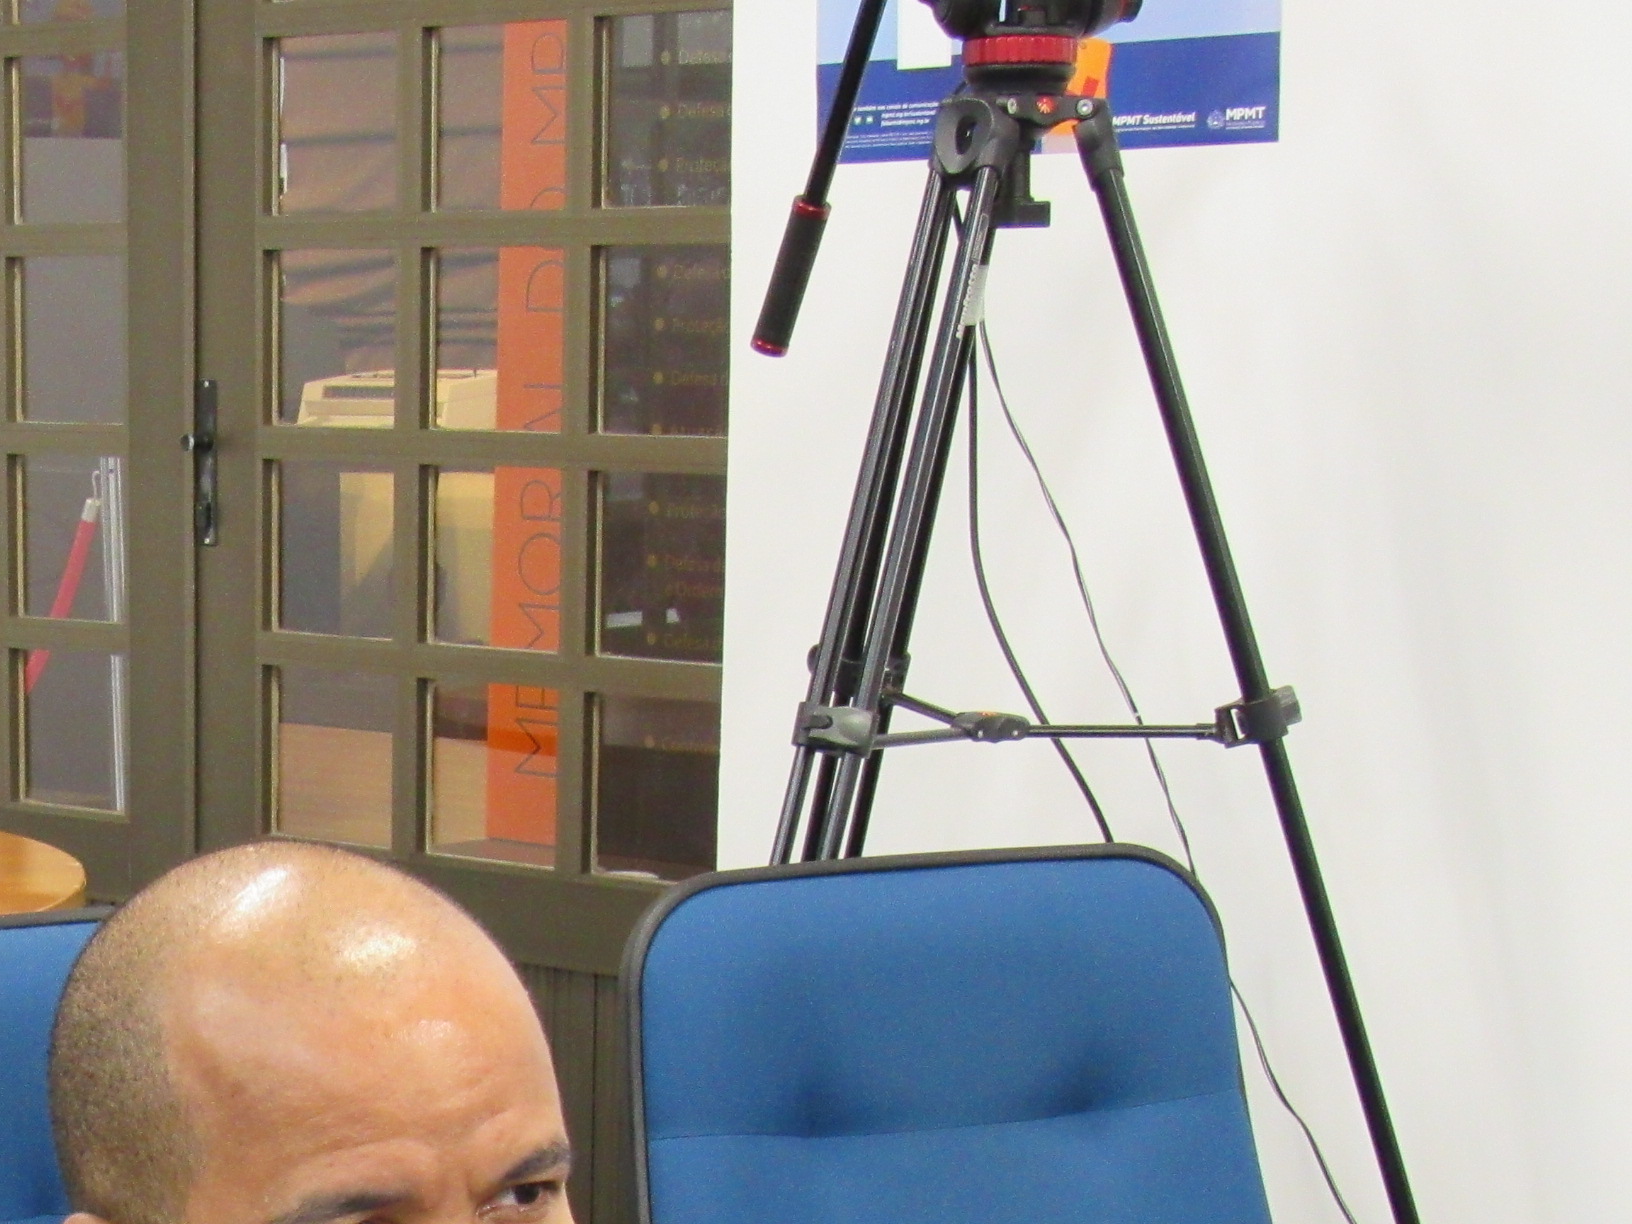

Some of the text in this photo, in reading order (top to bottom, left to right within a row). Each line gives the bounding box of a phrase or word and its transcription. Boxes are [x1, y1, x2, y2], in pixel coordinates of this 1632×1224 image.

[1112, 112, 1196, 127] MPMT Sustentável
[1226, 106, 1266, 121] MPMT
